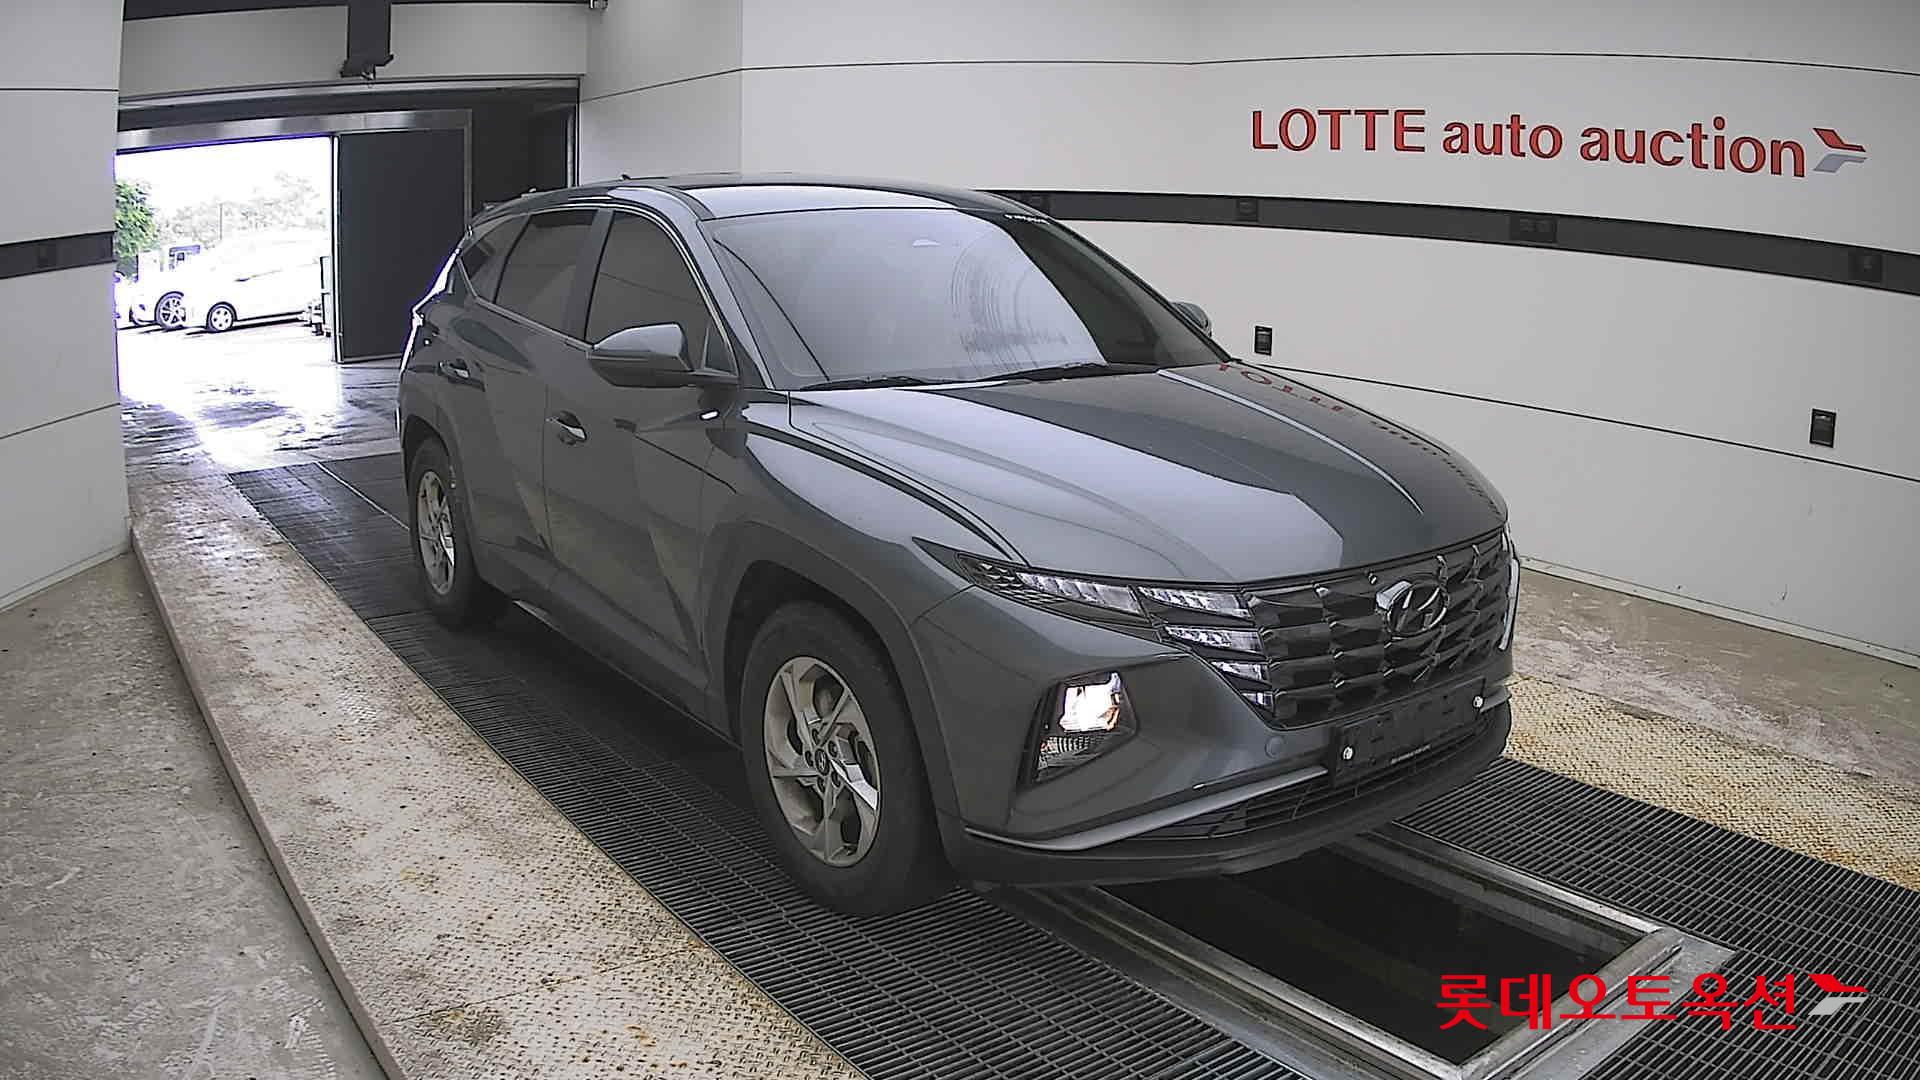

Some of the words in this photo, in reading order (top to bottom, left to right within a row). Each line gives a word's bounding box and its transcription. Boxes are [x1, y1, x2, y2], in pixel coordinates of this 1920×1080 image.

[1252, 108, 1426, 152] LOTTE
[1442, 114, 1563, 159] auto
[1579, 116, 1806, 178] auction
